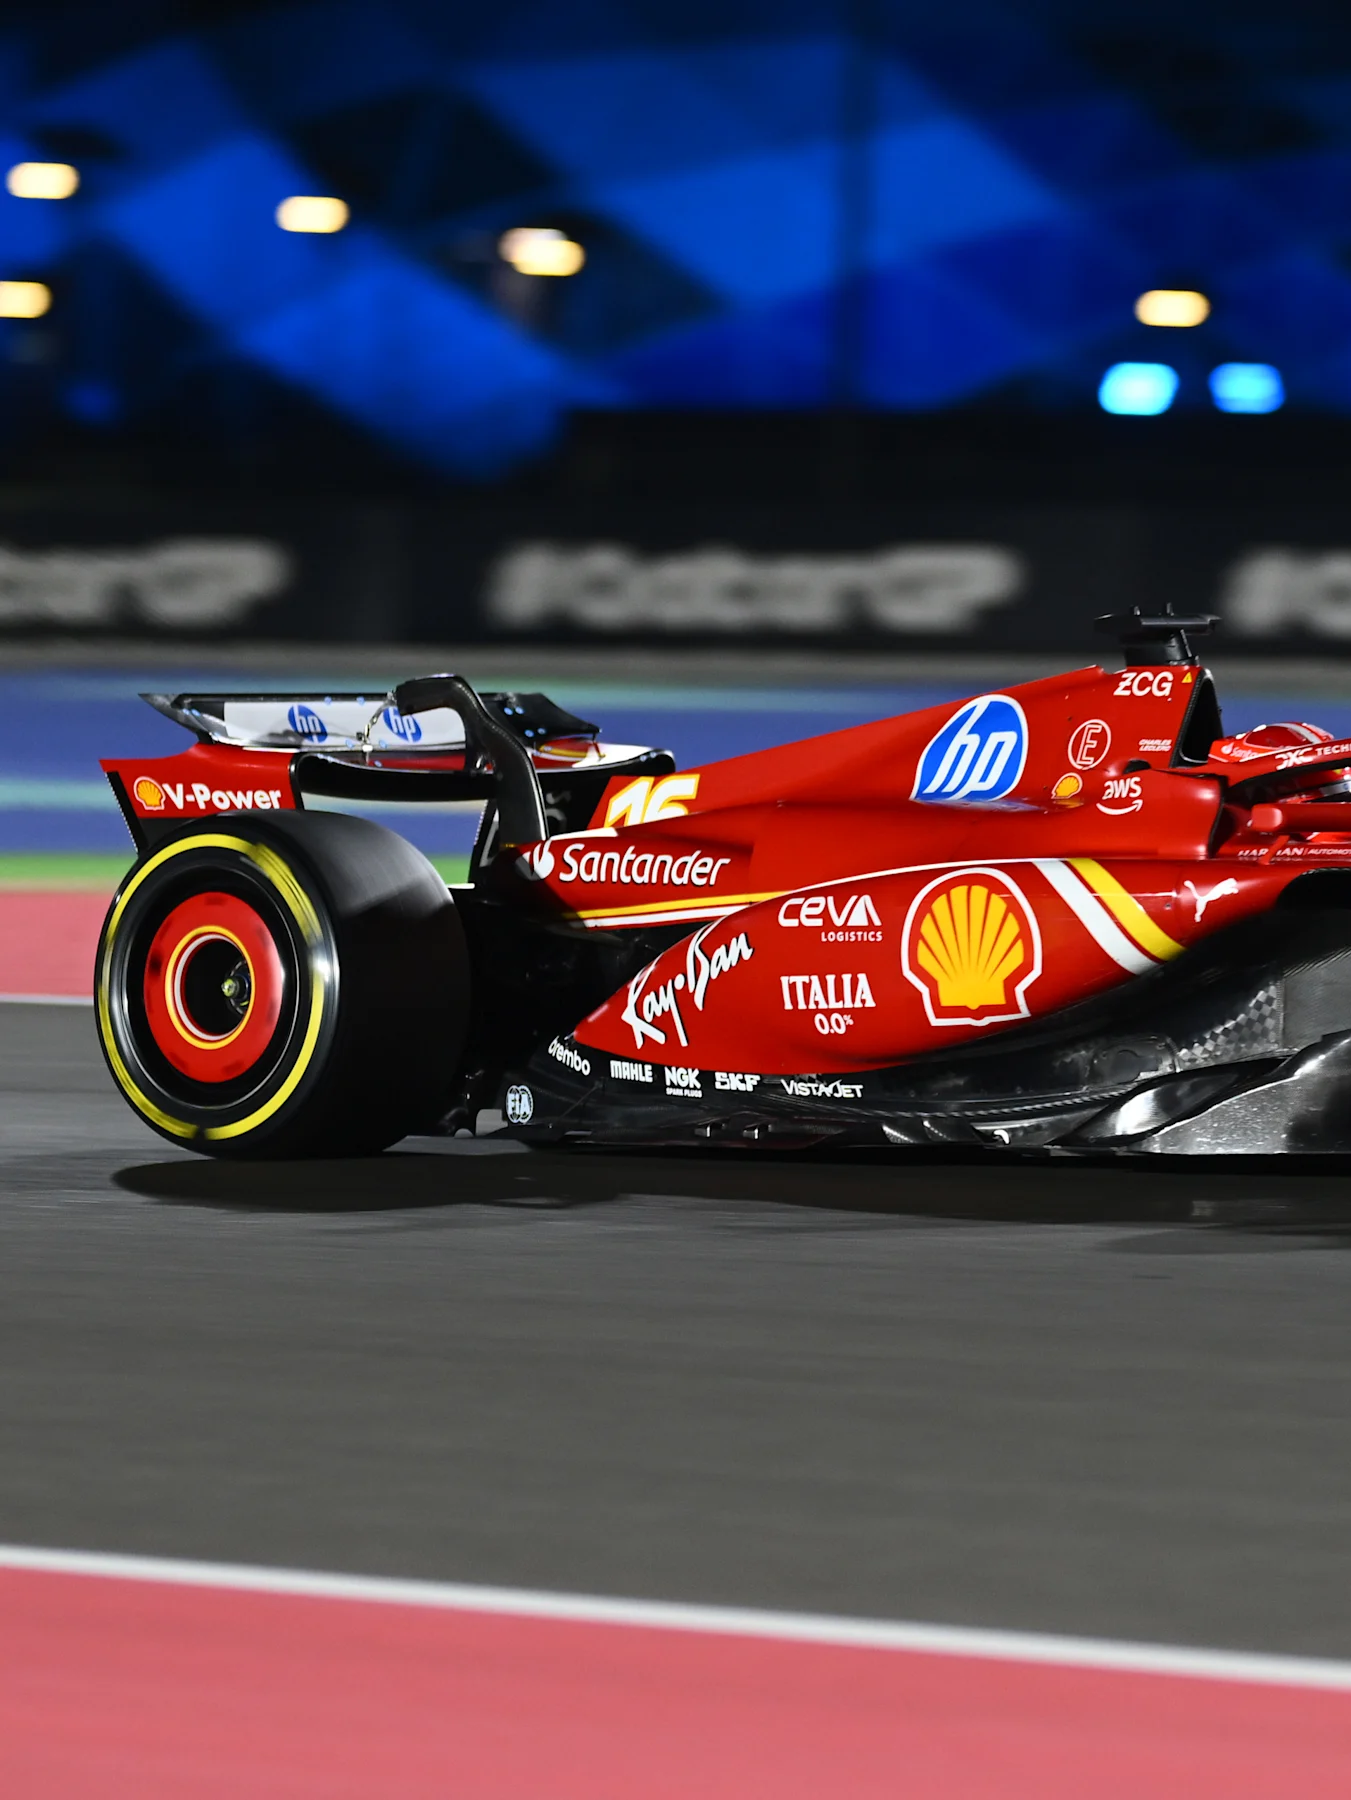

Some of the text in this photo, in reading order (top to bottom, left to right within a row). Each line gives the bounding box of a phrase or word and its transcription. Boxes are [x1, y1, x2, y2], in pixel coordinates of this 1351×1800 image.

[291, 704, 325, 743] hp
[386, 706, 420, 743] hp
[921, 695, 1018, 801] hp
[162, 783, 281, 810] V-Power
[603, 774, 700, 828] 16
[1102, 776, 1142, 800] aws
[559, 844, 730, 886] Santander
[778, 894, 883, 927] CEVA
[821, 931, 883, 942] LOGISTICS
[780, 973, 876, 1010] ITALIA
[814, 1012, 854, 1035] 0.0%
[548, 1036, 591, 1076] brembo
[610, 1060, 653, 1083] MAHLE
[664, 1066, 702, 1089] NGK
[714, 1072, 761, 1092] SKF
